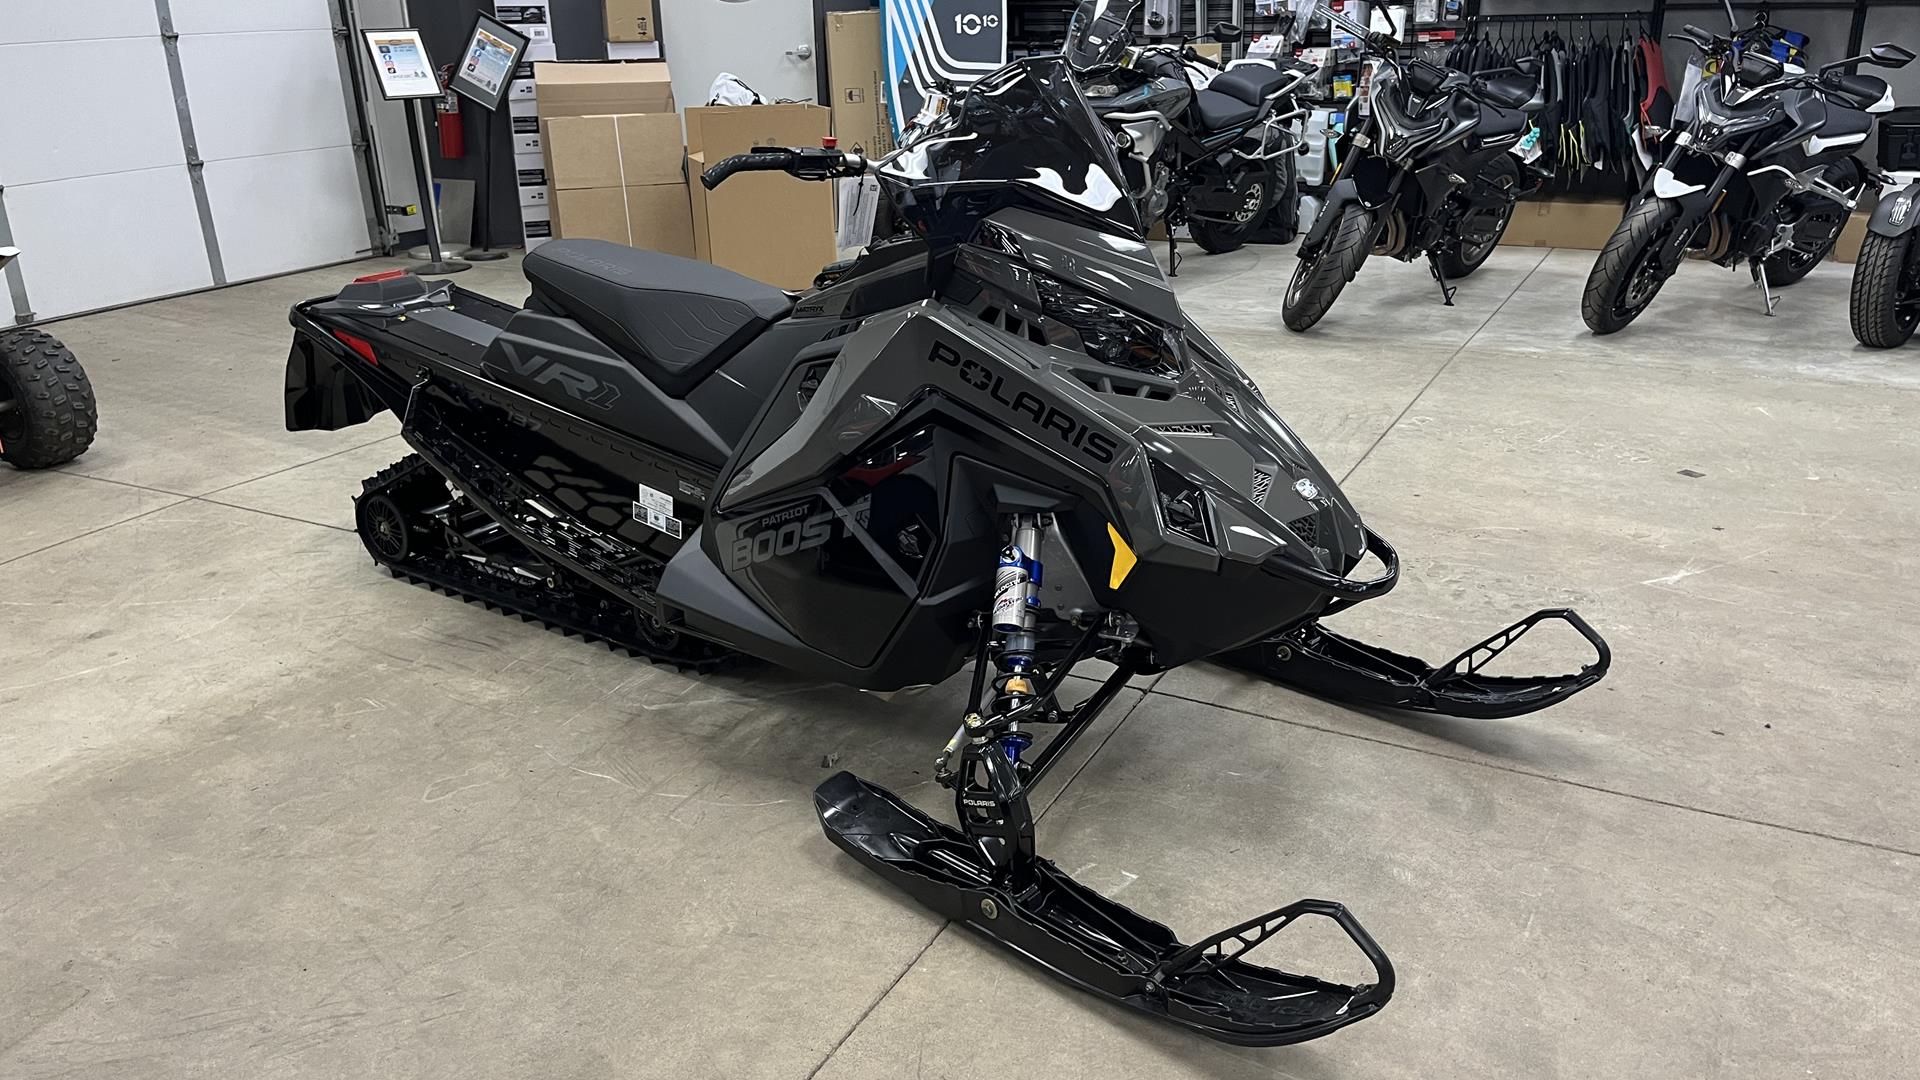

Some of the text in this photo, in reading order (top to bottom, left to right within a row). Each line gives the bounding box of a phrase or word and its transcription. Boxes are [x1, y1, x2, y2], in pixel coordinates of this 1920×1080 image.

[500, 340, 621, 411] VR1
[928, 339, 1118, 464] POLARIS
[731, 498, 872, 573] BOOST
[761, 503, 810, 528] PATRIOT
[962, 798, 996, 807] POLARIS
